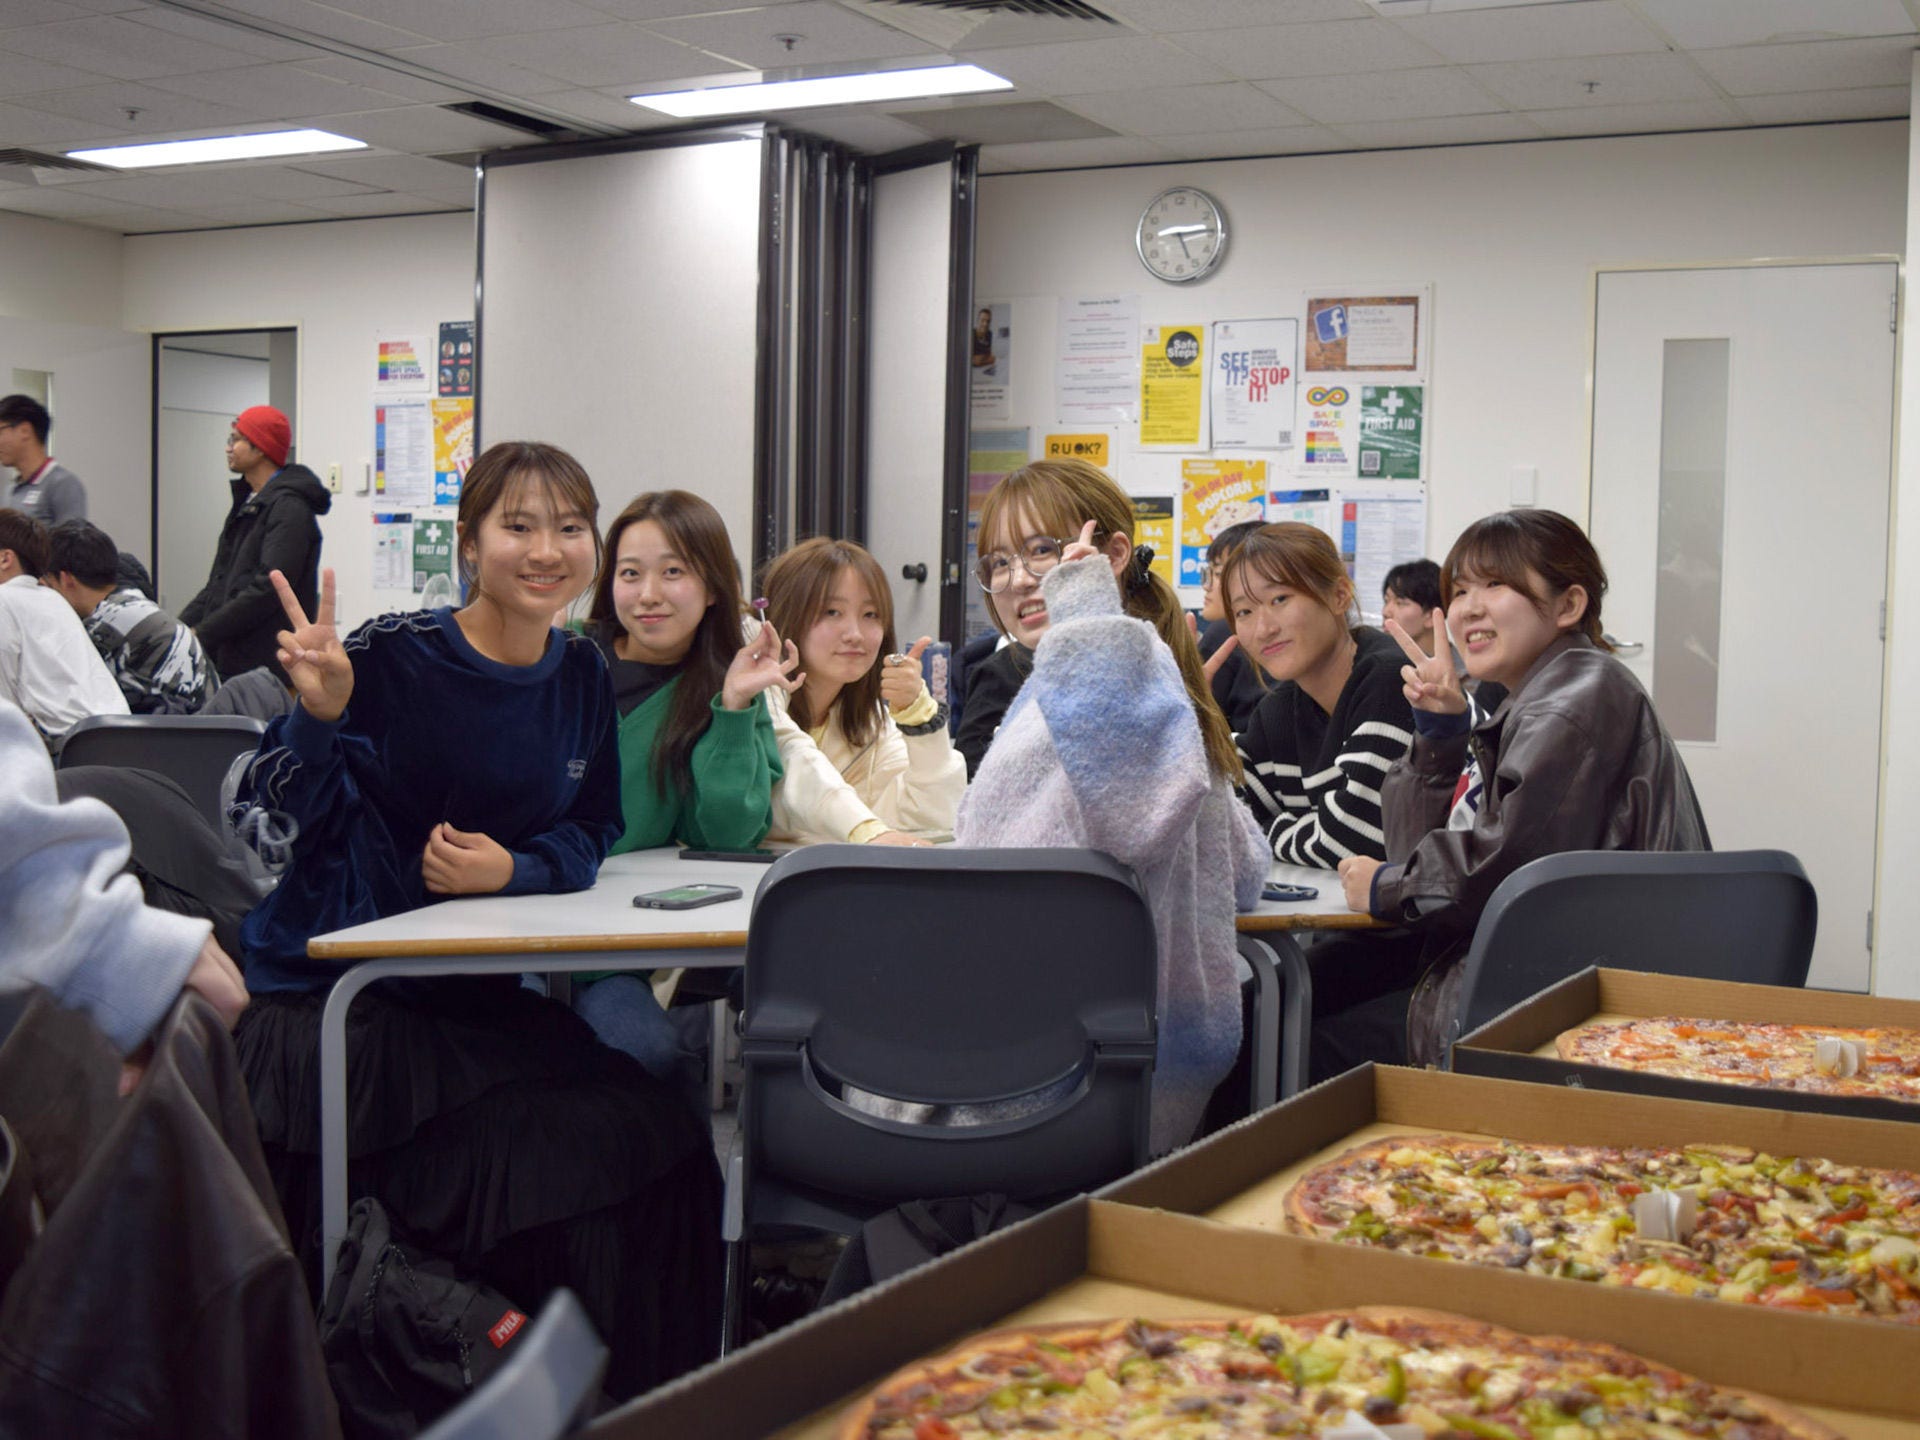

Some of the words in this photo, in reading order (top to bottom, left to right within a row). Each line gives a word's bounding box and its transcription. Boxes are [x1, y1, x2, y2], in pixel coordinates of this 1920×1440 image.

[1173, 340, 1197, 349] Safe
[1167, 347, 1197, 359] Steps
[1220, 352, 1249, 371] SEE
[1226, 368, 1248, 386] IT?
[1250, 367, 1290, 386] STOP
[1249, 384, 1268, 402] IT!
[1313, 411, 1341, 419] SAFE
[1365, 417, 1394, 430] FIRST
[1397, 418, 1415, 430] AID
[1051, 443, 1058, 454] R
[1062, 443, 1072, 454] U
[1074, 442, 1102, 455] OK?
[1223, 471, 1243, 485] DAY
[1196, 479, 1253, 516] POPCORN
[416, 544, 435, 555] FIRST
[436, 545, 449, 556] AID
[495, 1311, 521, 1341] MILK
